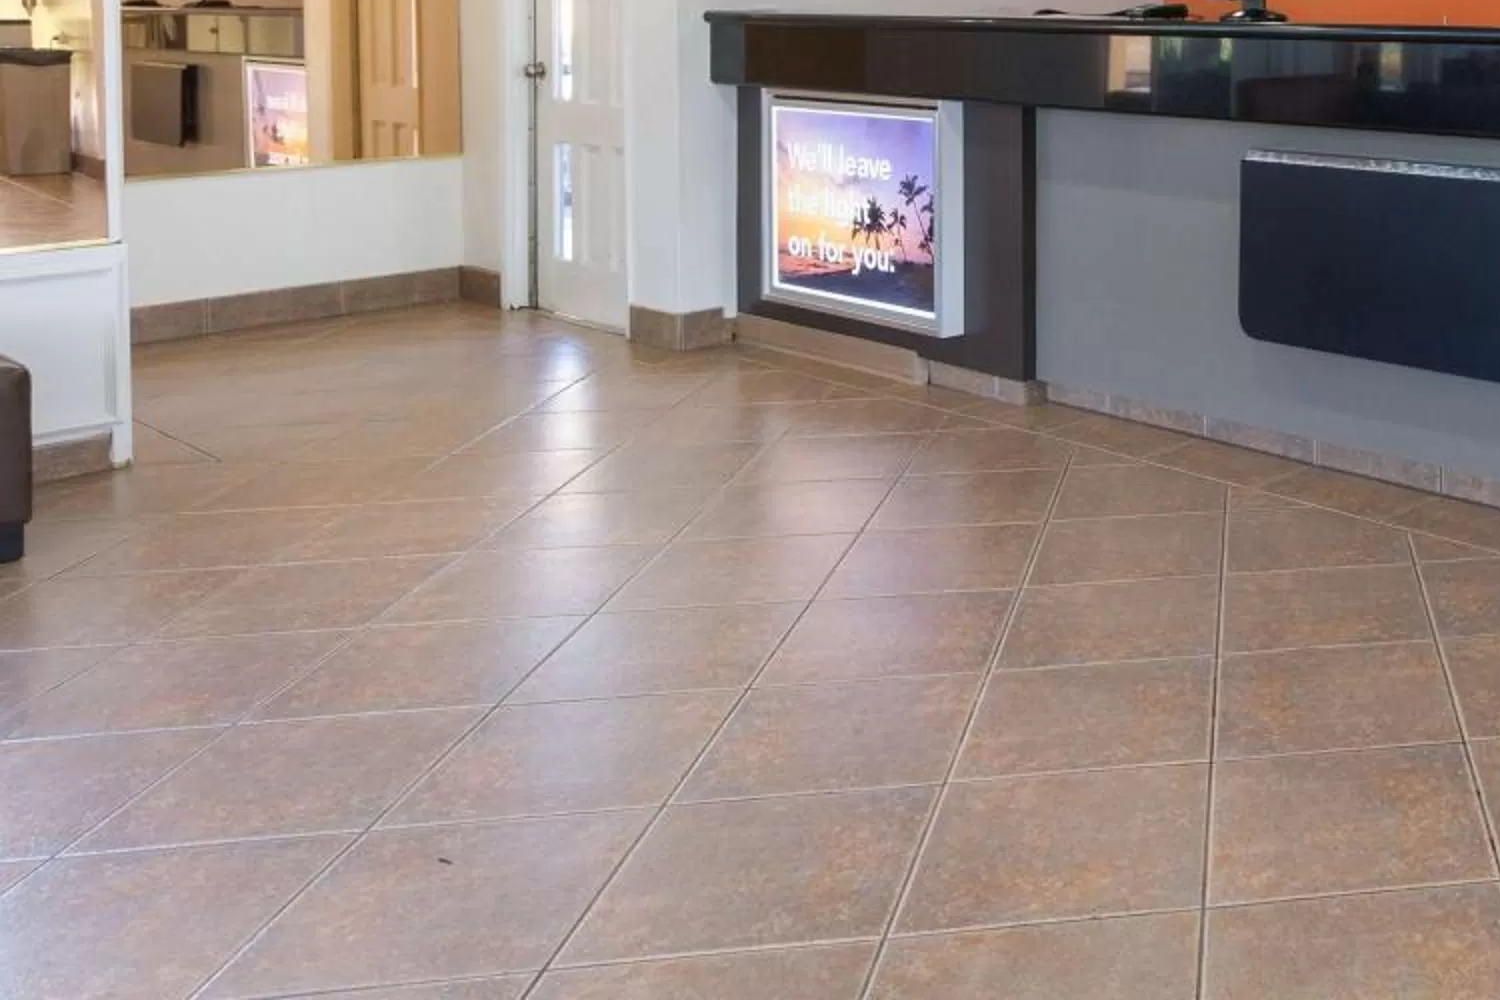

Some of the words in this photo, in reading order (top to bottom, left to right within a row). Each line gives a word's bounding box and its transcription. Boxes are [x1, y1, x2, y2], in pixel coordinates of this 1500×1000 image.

[787, 142, 833, 172] We'll
[839, 143, 892, 180] leave
[788, 236, 812, 257] on
[818, 231, 848, 262] for
